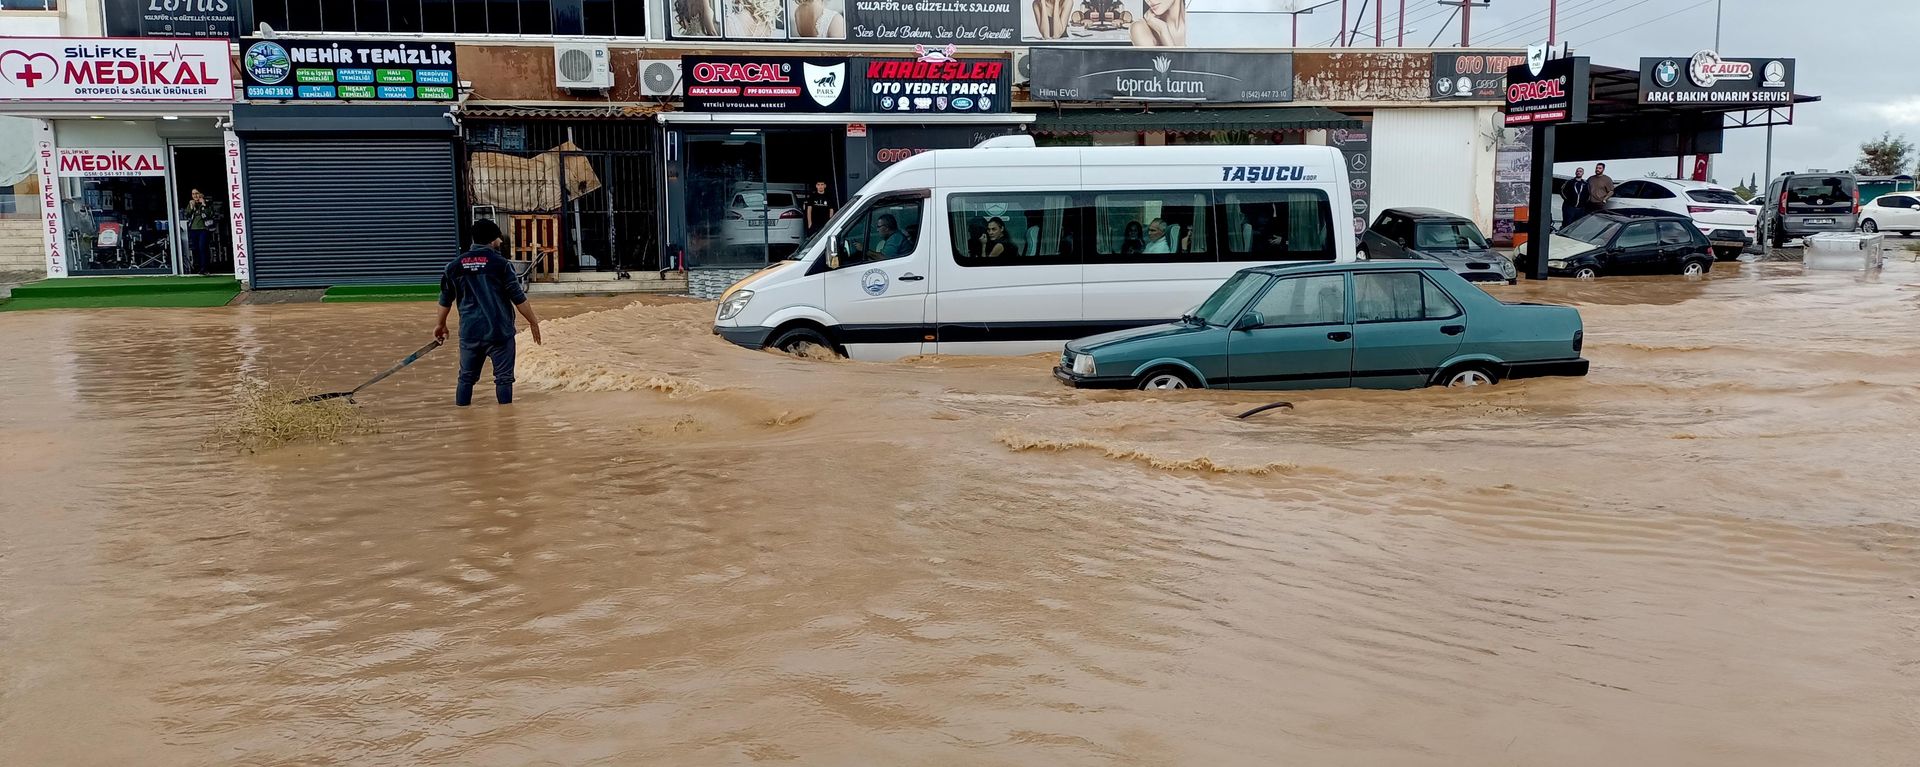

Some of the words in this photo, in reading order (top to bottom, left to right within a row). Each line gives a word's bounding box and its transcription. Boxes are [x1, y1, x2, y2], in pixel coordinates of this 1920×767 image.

[856, 0, 899, 11] KUAFÖR
[915, 0, 968, 12] GÜZELLİK
[969, 3, 1010, 13] SALONU
[935, 26, 953, 39] Size
[64, 44, 137, 58] SİLİFKE
[291, 43, 353, 64] NEHİR
[357, 44, 452, 64] TEMİZLİK
[64, 55, 219, 85] MEDİKAL
[867, 61, 1003, 81] KARDEŞLER
[1456, 55, 1484, 74] OTO
[1702, 64, 1716, 74] RC
[1718, 64, 1750, 74] AUTO
[75, 86, 120, 95] ORTOPEDİ
[130, 86, 162, 95] SAĞLIK
[163, 86, 207, 95] ÜRÜNLERİ
[248, 88, 264, 96] 0530
[264, 88, 276, 96] 467
[276, 88, 284, 96] 38
[284, 88, 293, 96] 00
[872, 82, 900, 95] OTO
[904, 82, 950, 95] YEDEK
[951, 82, 996, 97] PARÇA
[1039, 88, 1058, 97] Hilmi
[1117, 76, 1162, 96] toprak
[1166, 78, 1204, 93] tarım
[1247, 90, 1260, 100] (542)
[1280, 90, 1287, 98] 10
[1648, 92, 1674, 103] ARAÇ
[1677, 92, 1708, 101] BAKIM
[1710, 92, 1750, 101] ONARIM
[60, 150, 165, 172] MEDİKAL
[877, 148, 912, 162] OTO
[40, 150, 54, 208] SİLİFKE
[228, 150, 241, 208] SİLİFKE
[1222, 166, 1304, 184] TAŞUCU
[46, 212, 60, 264] MEDİKAL
[233, 212, 246, 266] MEDİKAL
